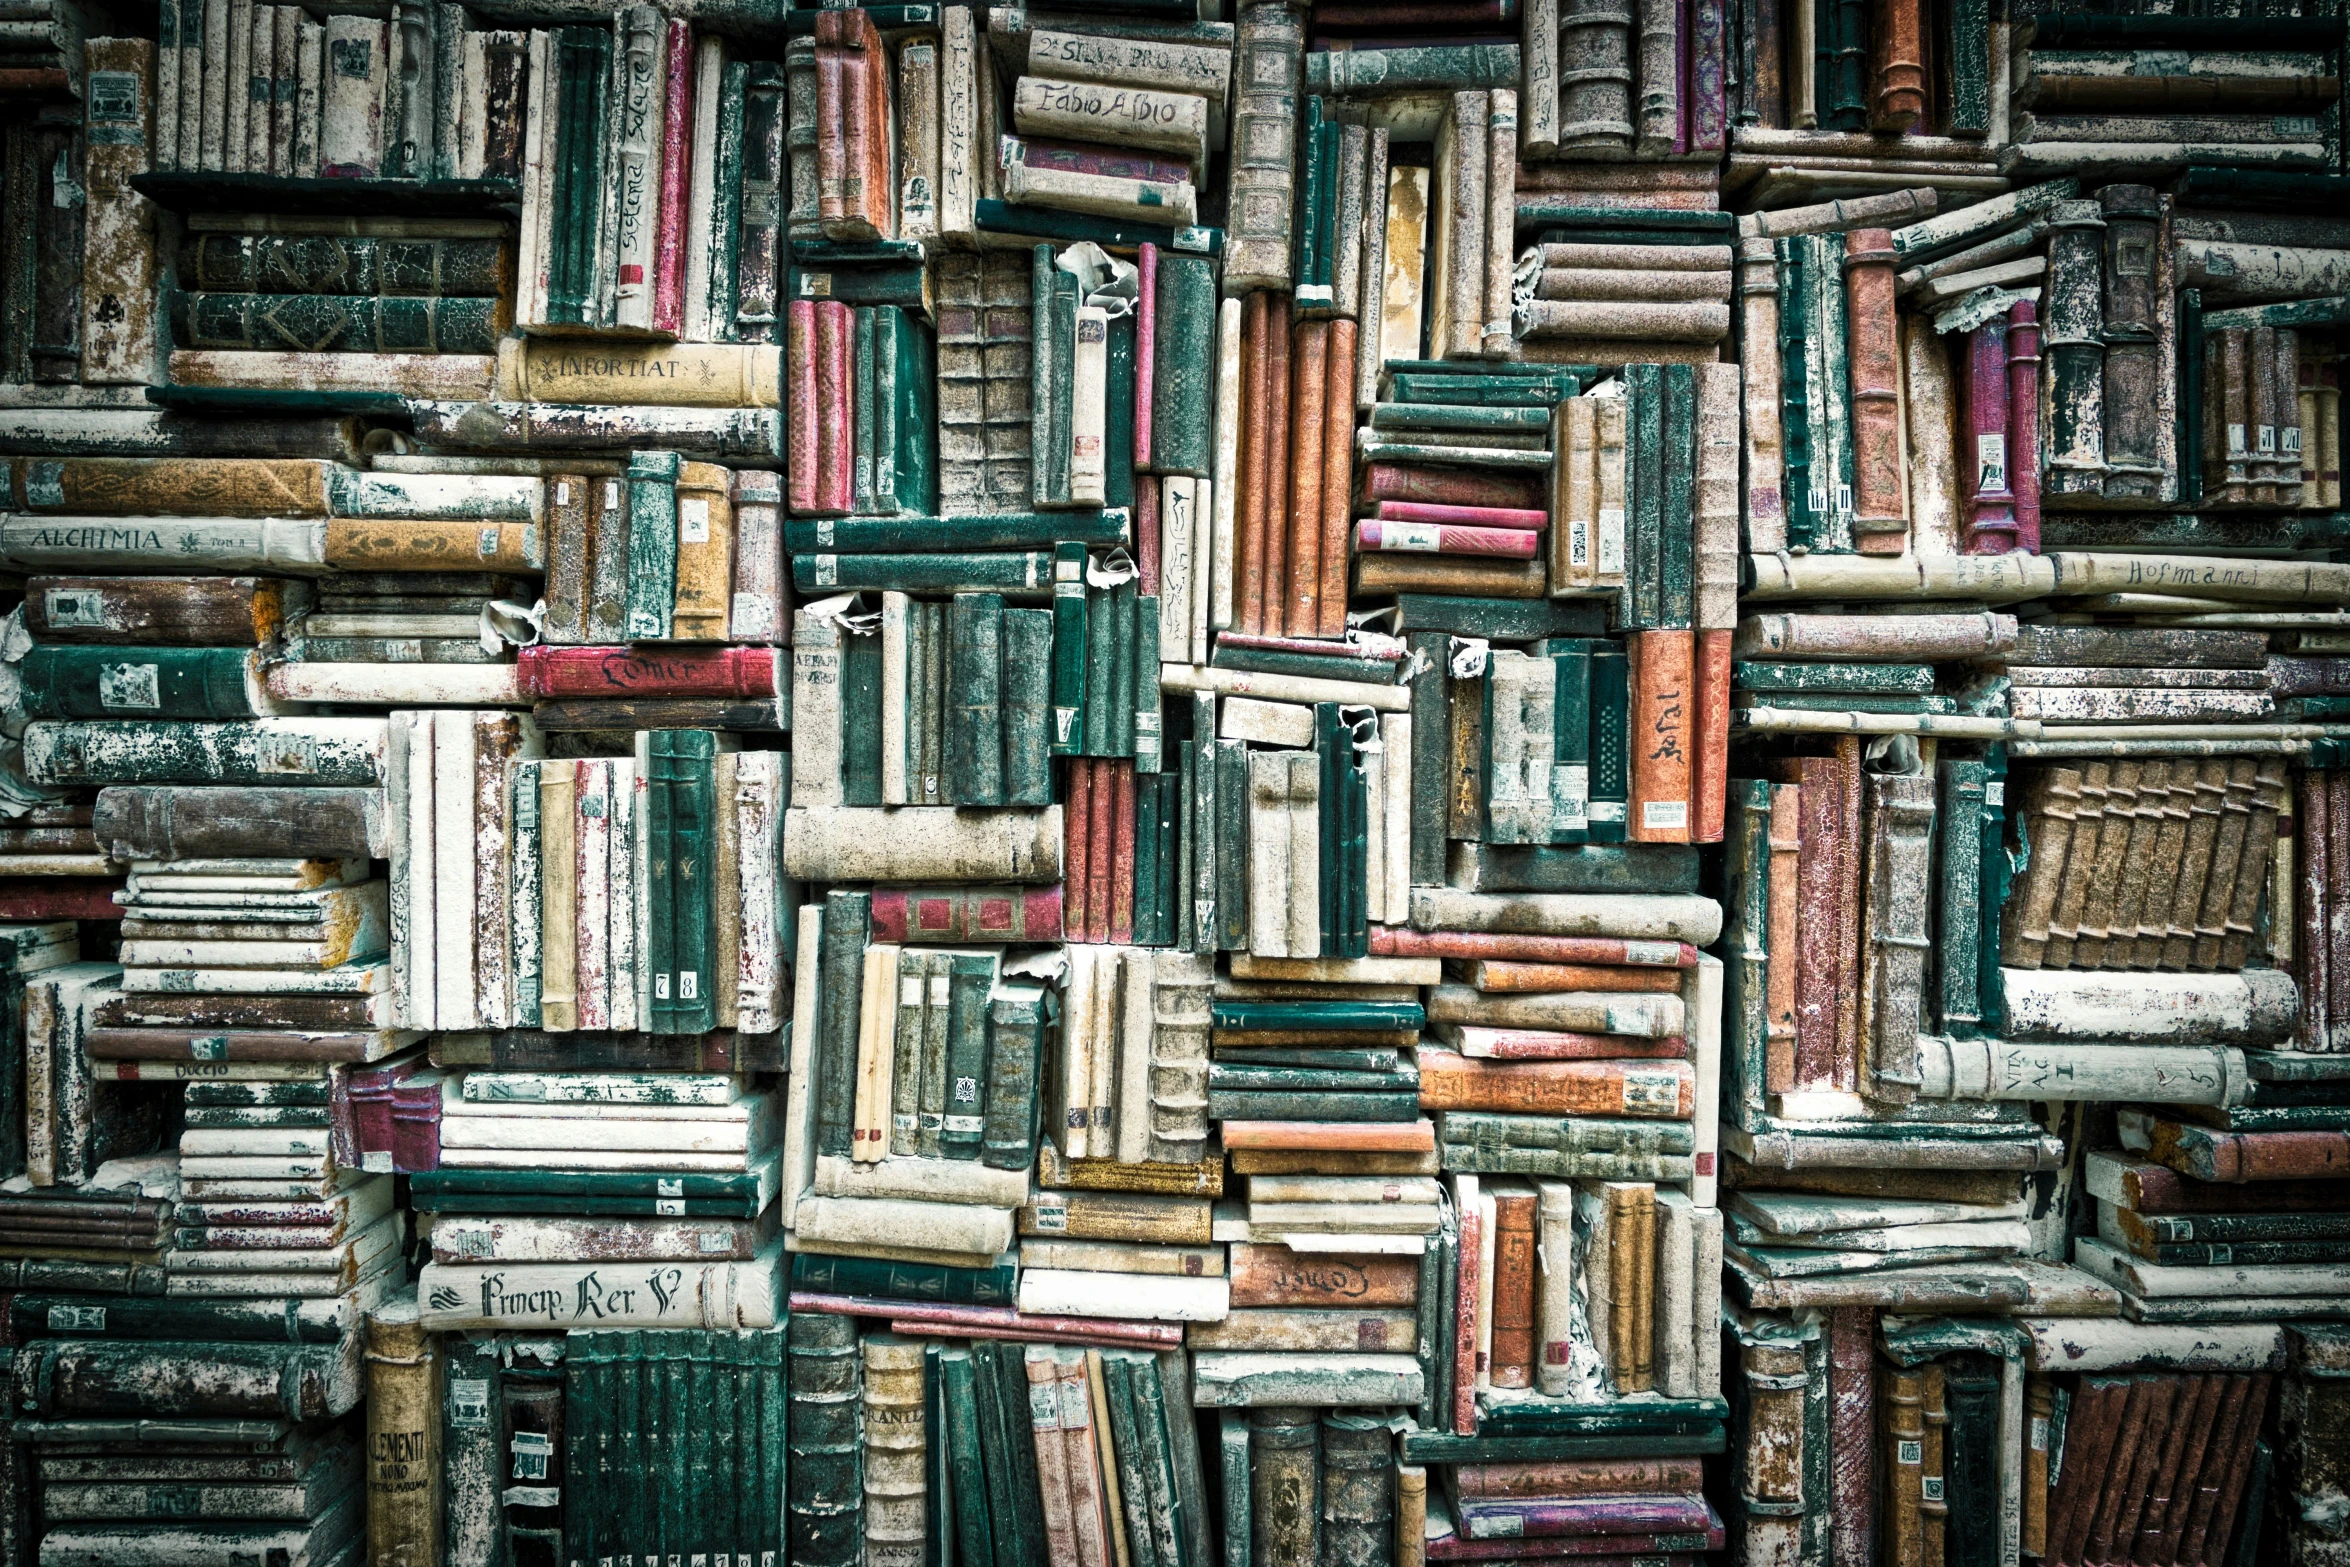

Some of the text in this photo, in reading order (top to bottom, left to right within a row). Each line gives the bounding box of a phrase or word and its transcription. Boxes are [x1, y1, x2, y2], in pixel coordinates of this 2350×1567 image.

[1033, 83, 1101, 115] Fabio
[622, 58, 652, 251] Sistema Solare
[30, 527, 164, 550] ALCHIMIA
[2126, 560, 2260, 586] Hofmanni
[926, 777, 936, 794] 6
[656, 975, 667, 995] 7
[682, 977, 693, 998] 8
[2006, 1049, 2022, 1091] VITA
[368, 1431, 424, 1463] CLEMENTI
[380, 1464, 408, 1480] NONO
[2004, 1496, 2017, 1520] SIR
